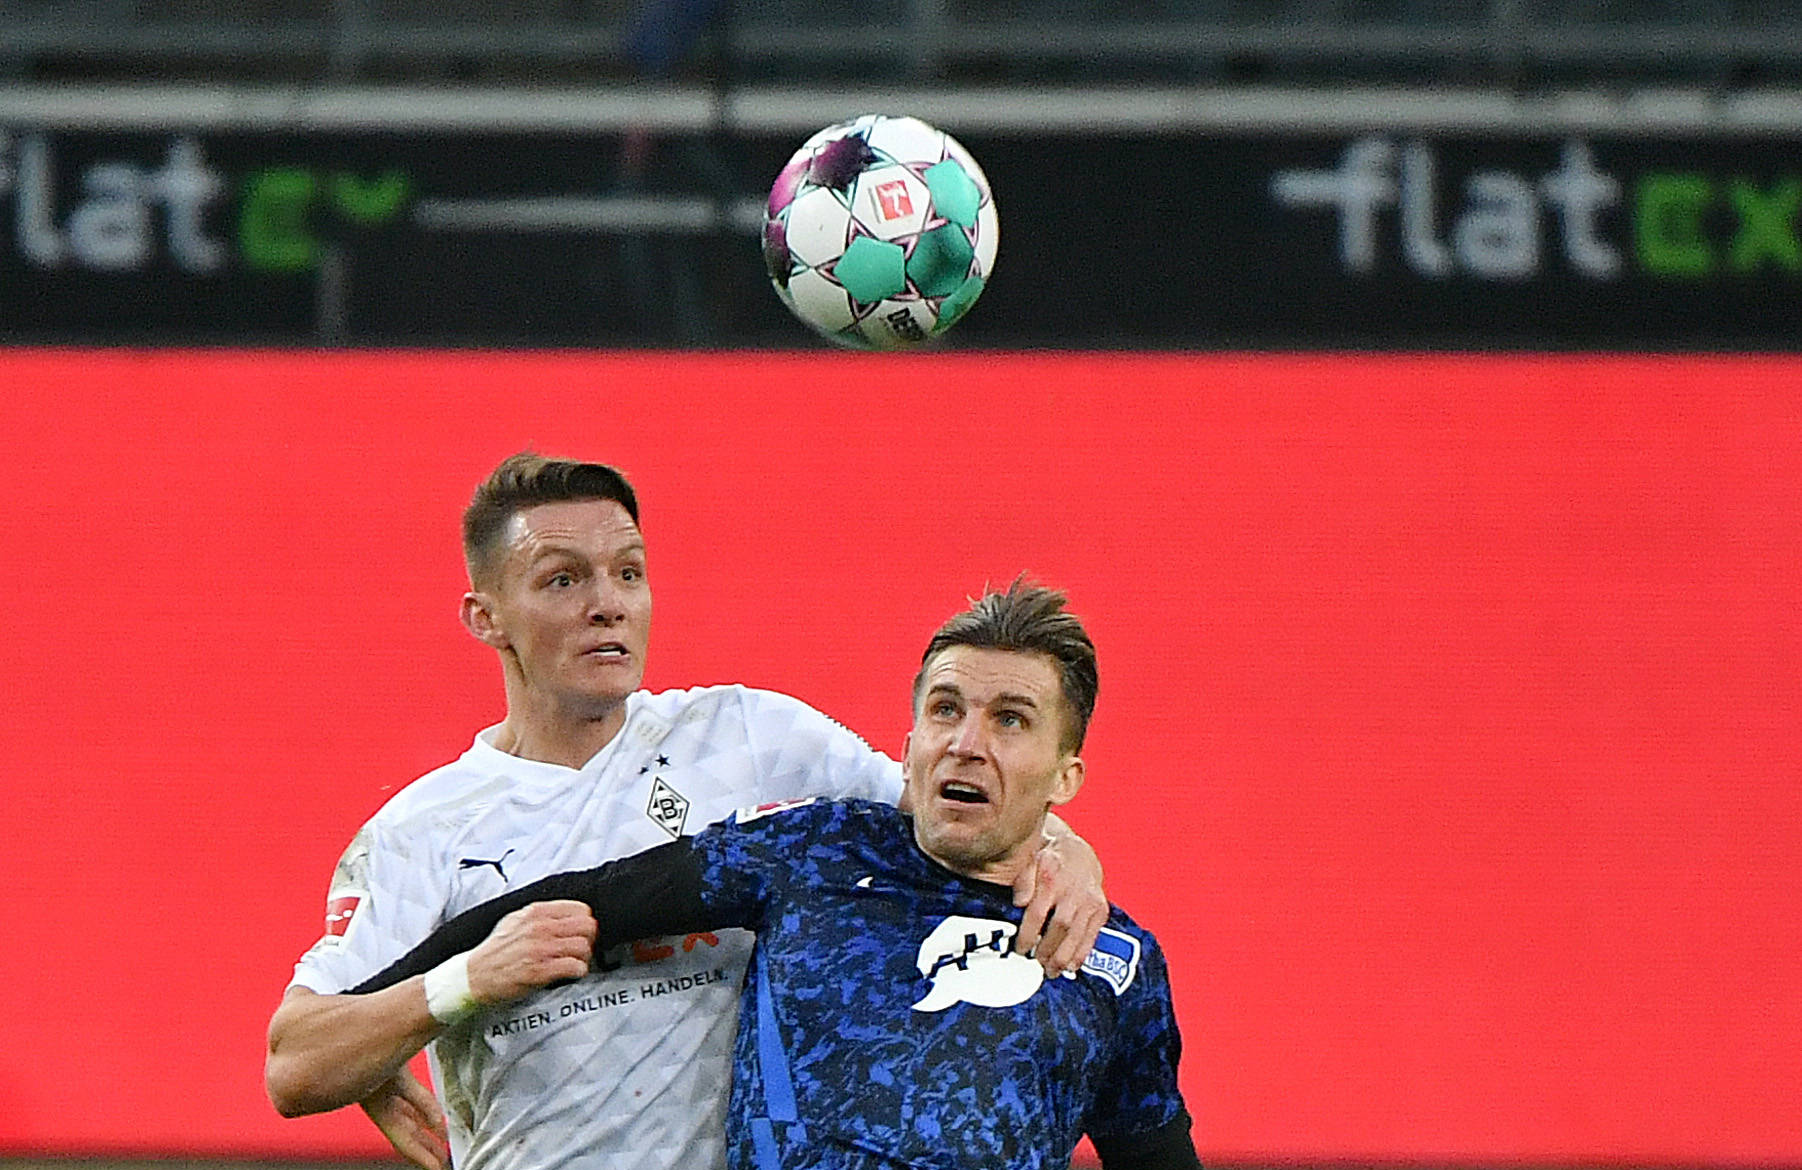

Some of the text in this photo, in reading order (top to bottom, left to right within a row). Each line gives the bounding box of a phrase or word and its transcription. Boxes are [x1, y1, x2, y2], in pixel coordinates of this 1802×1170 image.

[492, 968, 729, 1038] AKTIEN. ONLINE. HANDELN.
